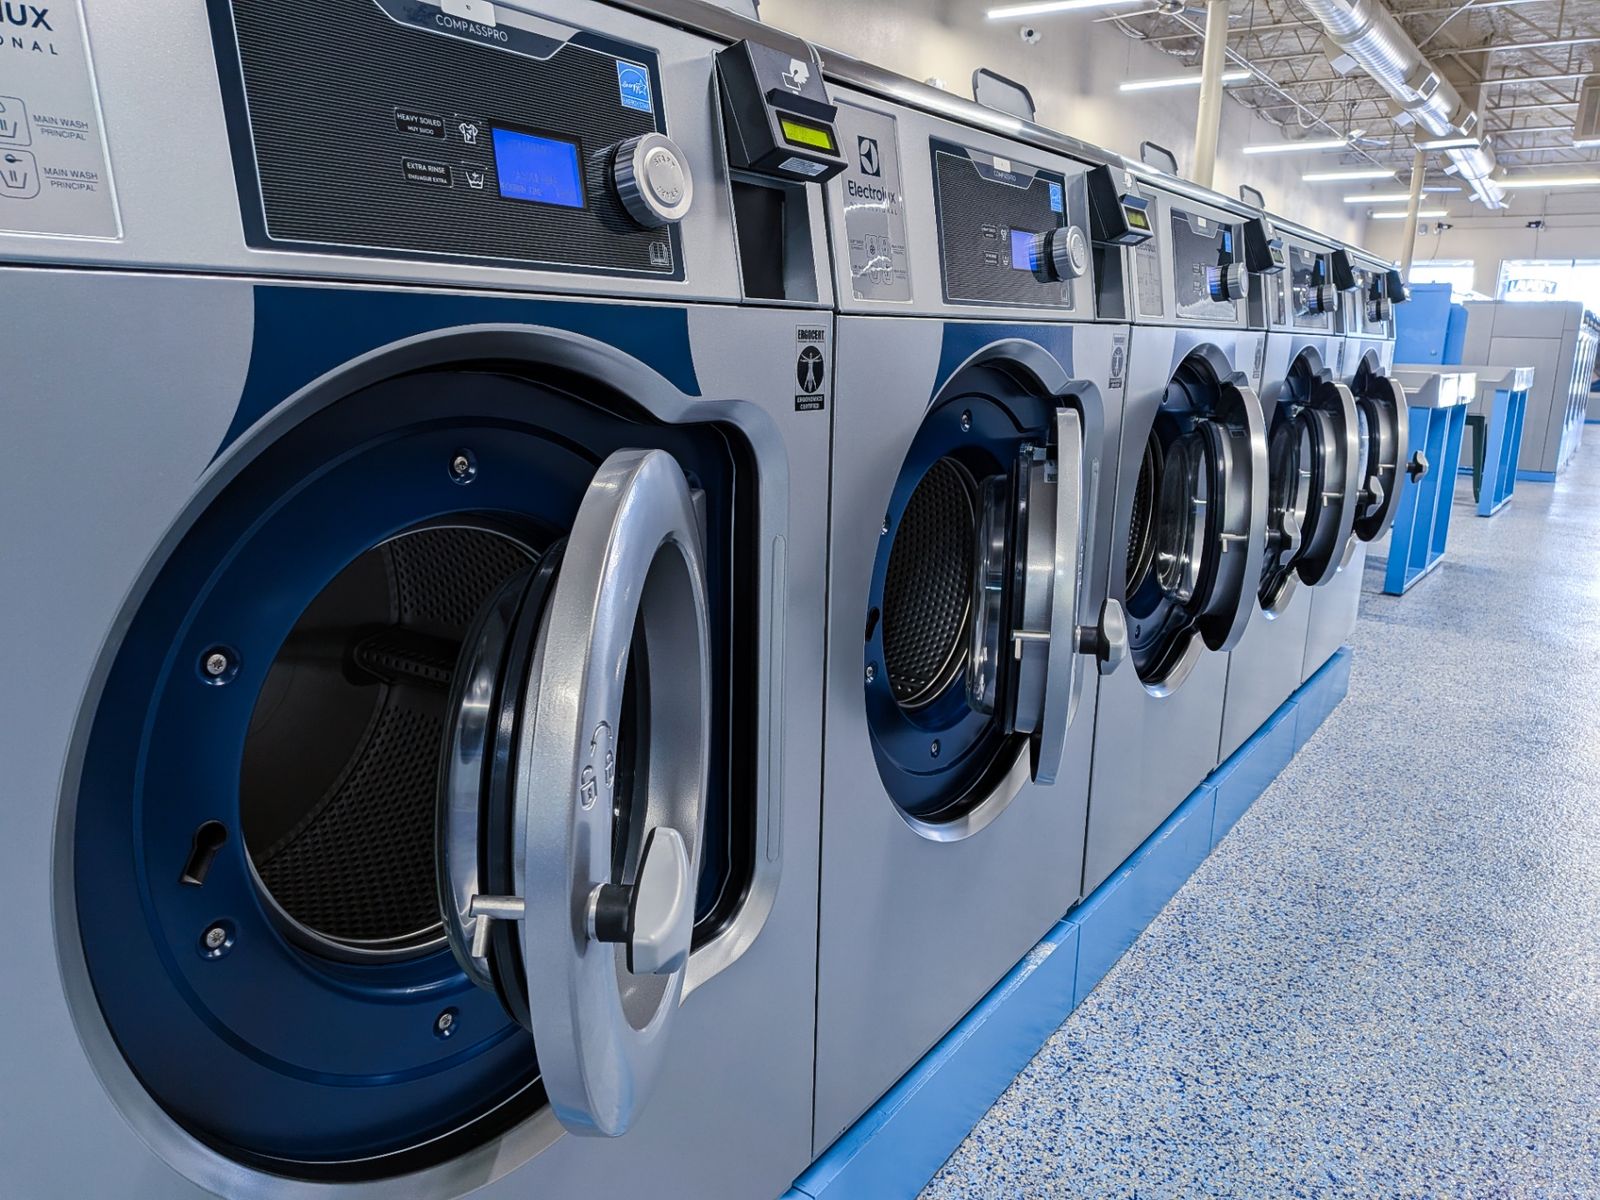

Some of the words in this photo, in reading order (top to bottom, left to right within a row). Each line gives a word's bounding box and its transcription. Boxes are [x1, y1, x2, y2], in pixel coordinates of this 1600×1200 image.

[435, 14, 508, 42] COMPASSPRO
[33, 114, 59, 126] MAIN
[60, 118, 89, 129] WASH
[397, 112, 419, 122] HEAVY
[420, 117, 442, 127] SOILED
[41, 128, 87, 141] PRINCIPAL
[43, 167, 68, 178] MAIN
[70, 171, 98, 180] WASH
[406, 161, 427, 171] EXTRA
[427, 165, 446, 174] RINSE
[50, 180, 97, 192] PRINCIPAL
[847, 179, 896, 204] Electrolux
